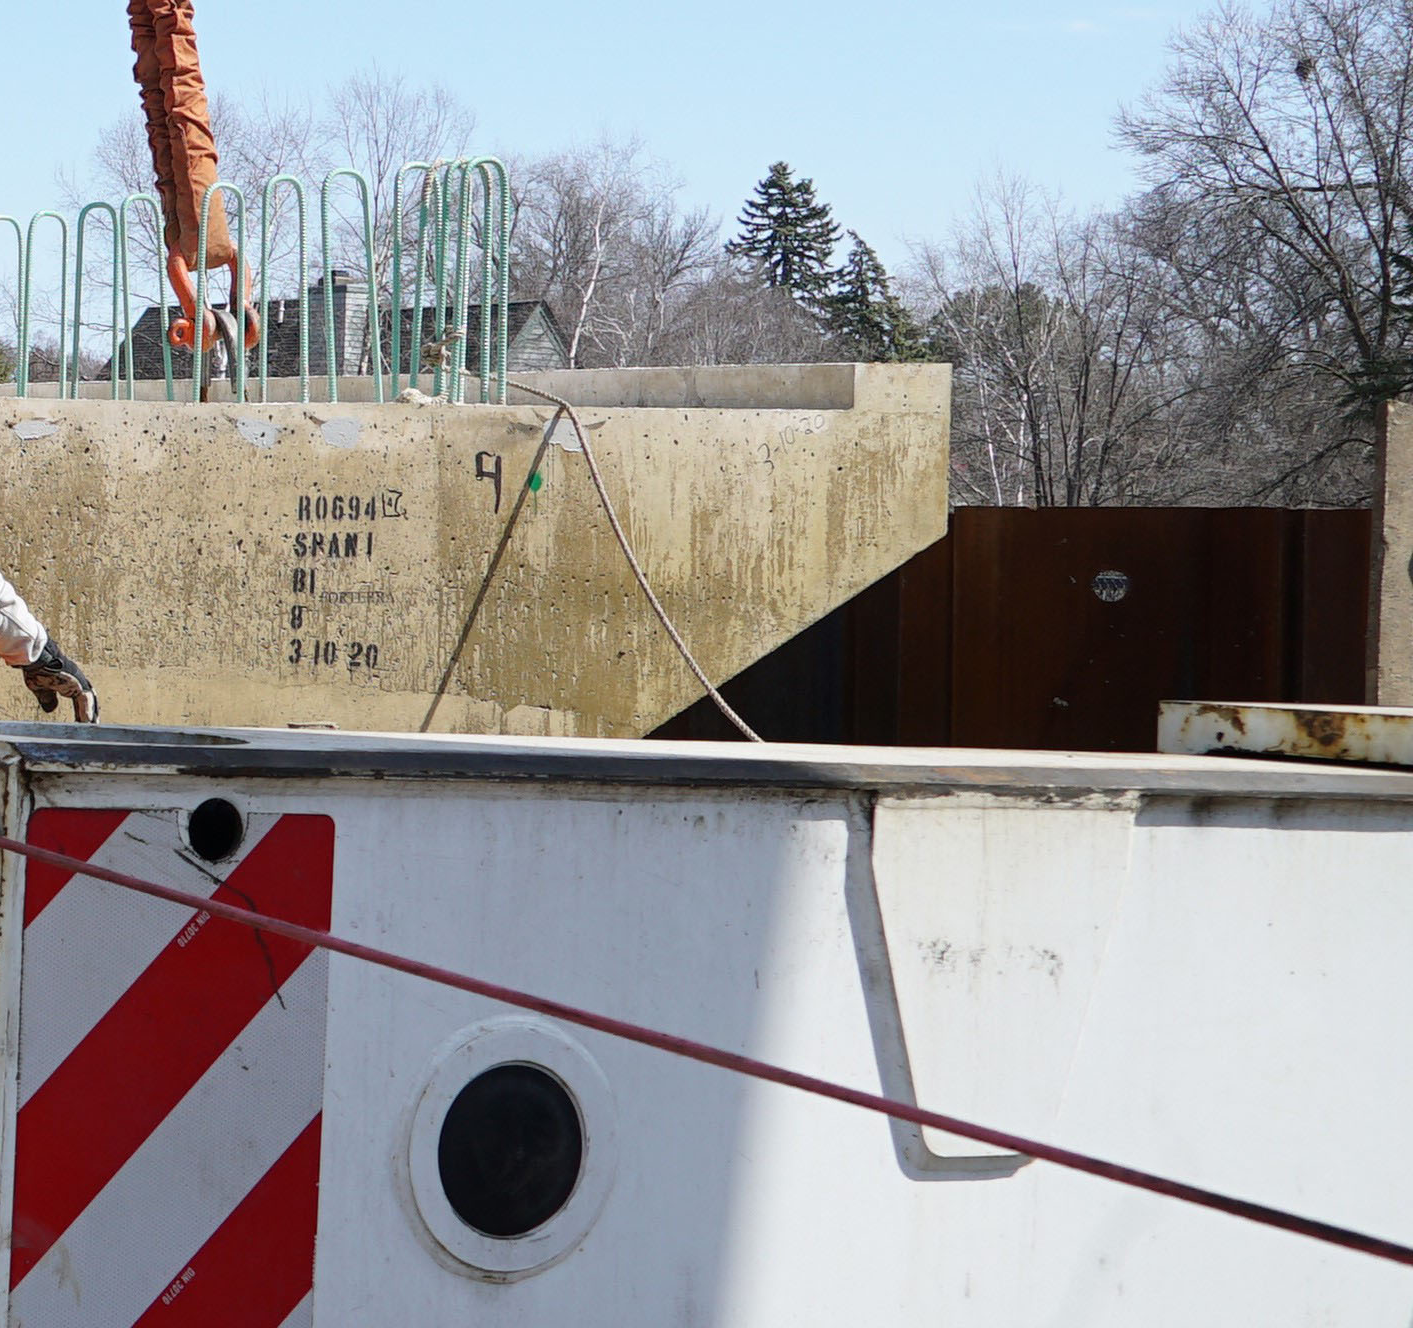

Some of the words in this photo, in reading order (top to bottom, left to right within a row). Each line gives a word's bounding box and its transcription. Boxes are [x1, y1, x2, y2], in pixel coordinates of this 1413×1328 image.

[293, 532, 358, 558] SPAN
[289, 639, 302, 664] 3
[347, 642, 378, 668] 20
